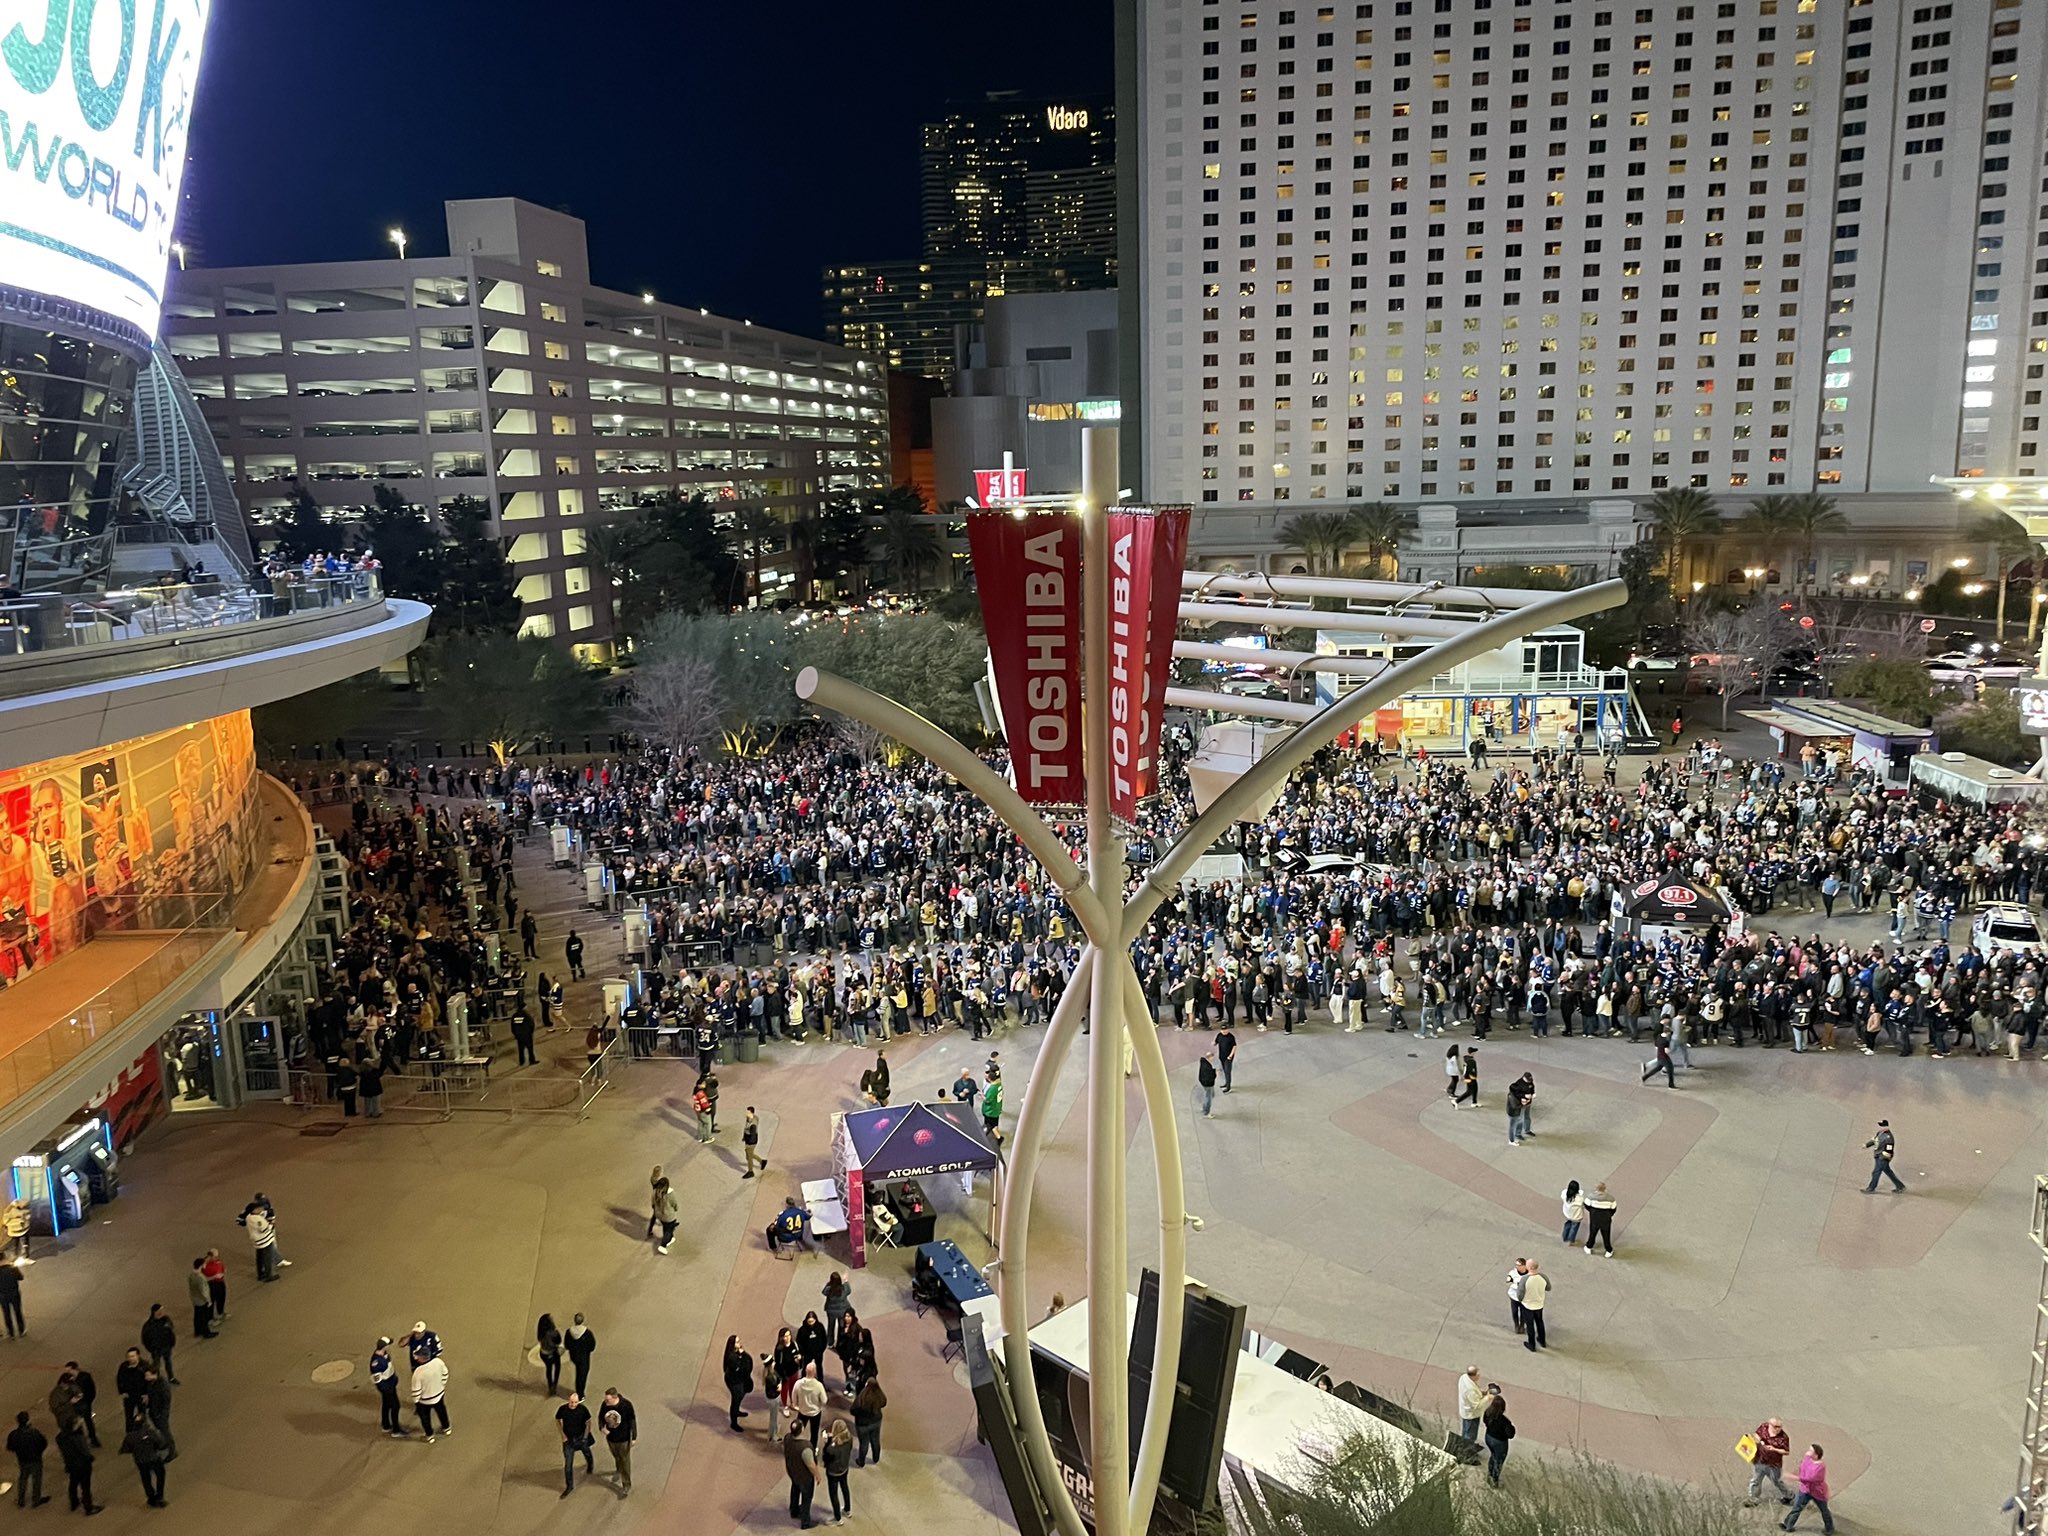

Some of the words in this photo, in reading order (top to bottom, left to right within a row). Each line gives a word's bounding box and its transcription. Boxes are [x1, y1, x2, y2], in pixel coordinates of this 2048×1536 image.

[1047, 105, 1088, 130] Vdara
[0, 109, 148, 233] WORLD
[1024, 528, 1069, 788] TOSHIBA
[1111, 532, 1133, 801] TOSHIBA
[1664, 889, 1690, 900] 97.1
[887, 1166, 934, 1178] ATOMIC
[938, 1161, 972, 1172] GOLF
[786, 1214, 802, 1231] 34
